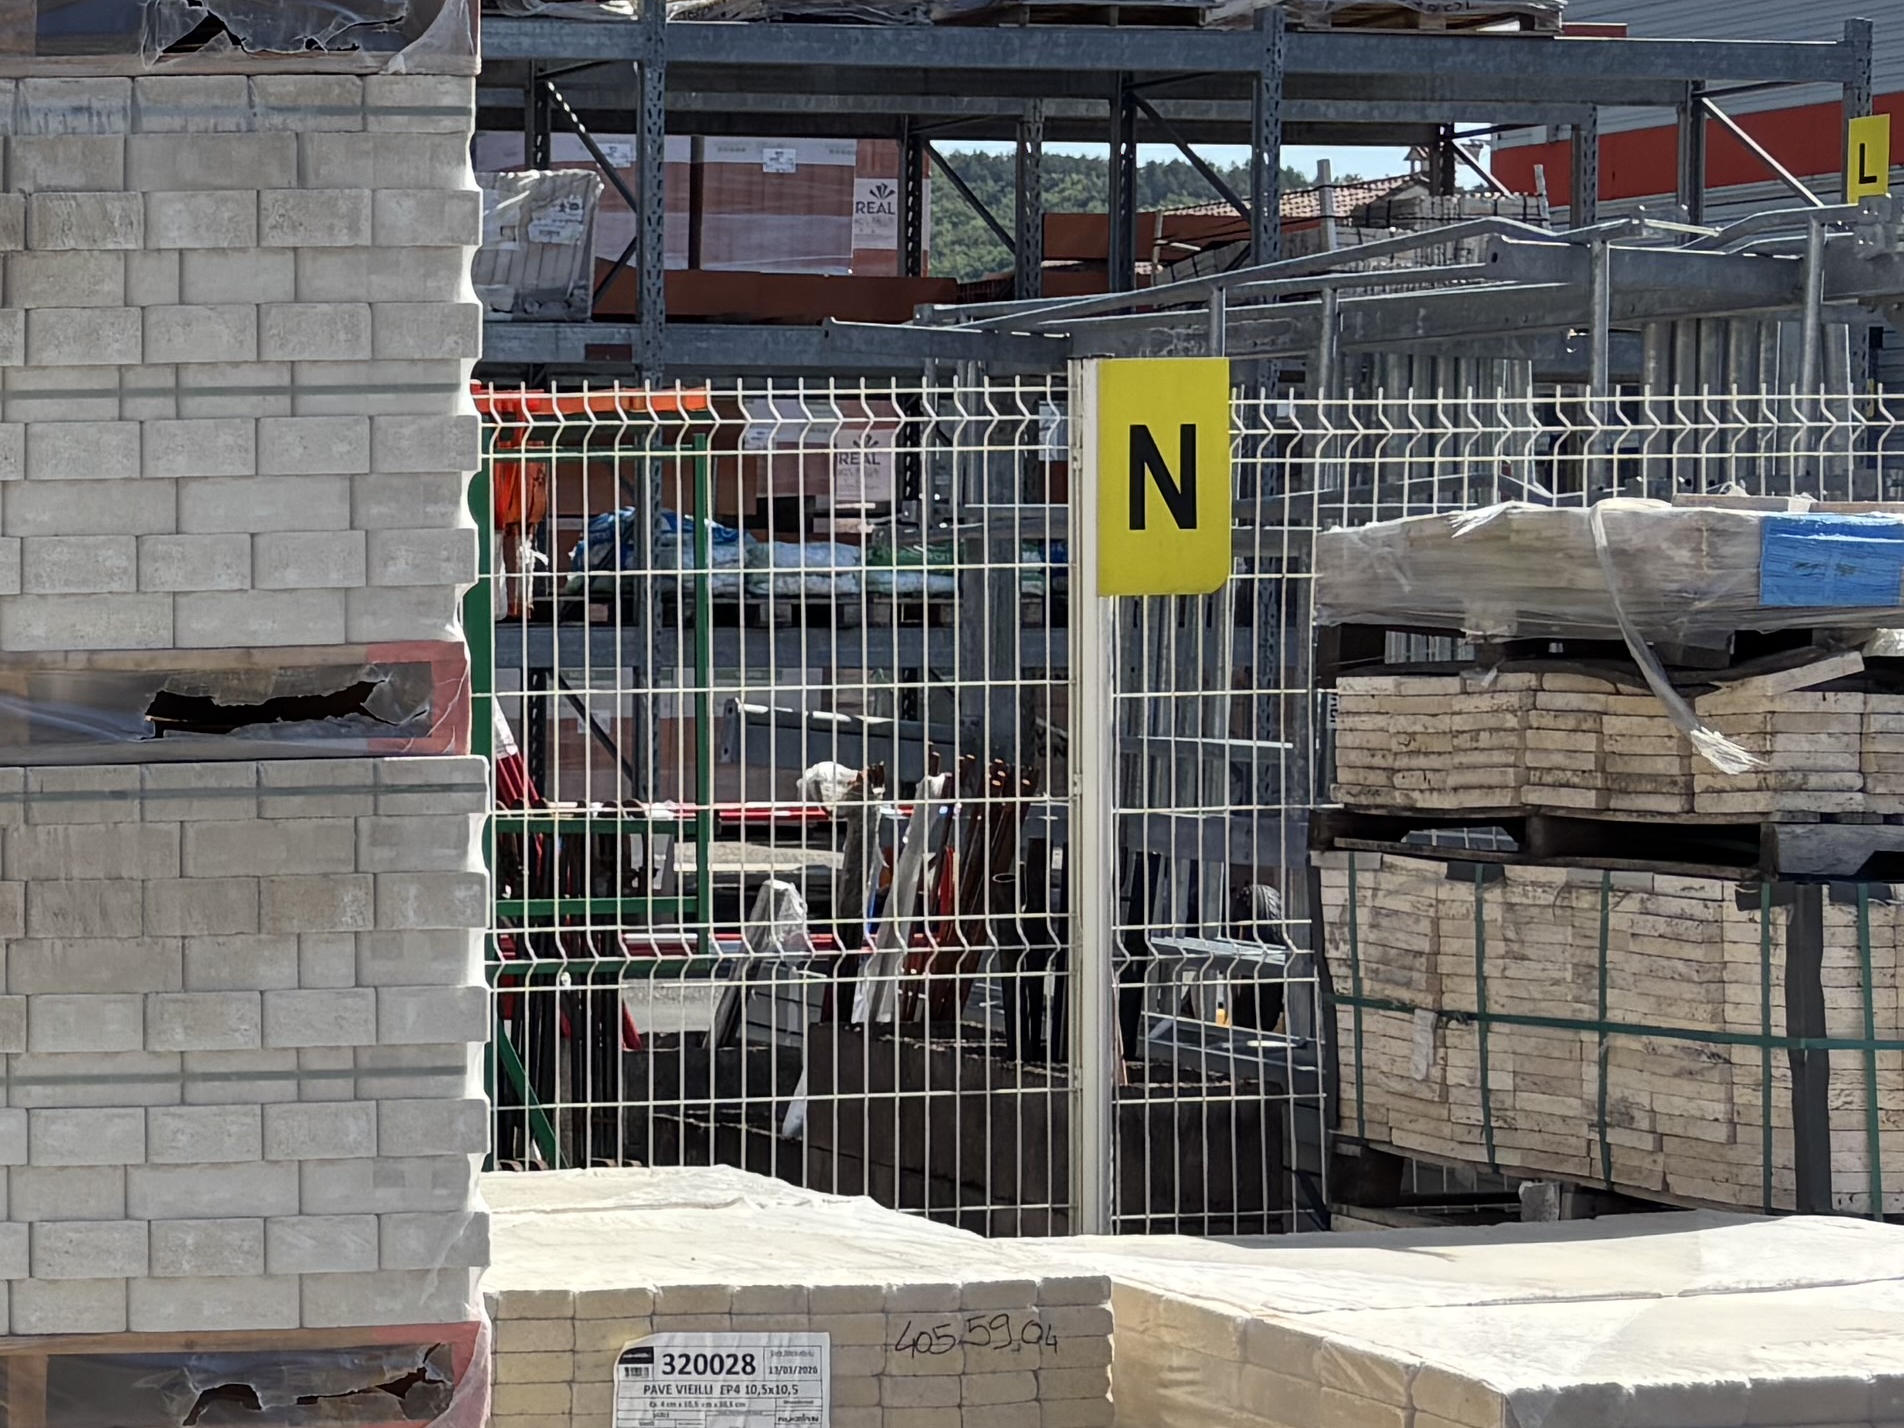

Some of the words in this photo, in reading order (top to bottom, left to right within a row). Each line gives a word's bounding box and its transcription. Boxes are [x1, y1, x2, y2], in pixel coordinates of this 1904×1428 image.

[1859, 143, 1877, 184] L
[856, 201, 896, 215] REAL
[1129, 423, 1197, 530] N
[661, 1353, 757, 1376] 320028
[643, 1384, 673, 1396] PAVE
[719, 1383, 741, 1395] EP4
[745, 1383, 799, 1397] 10,5x10,5
